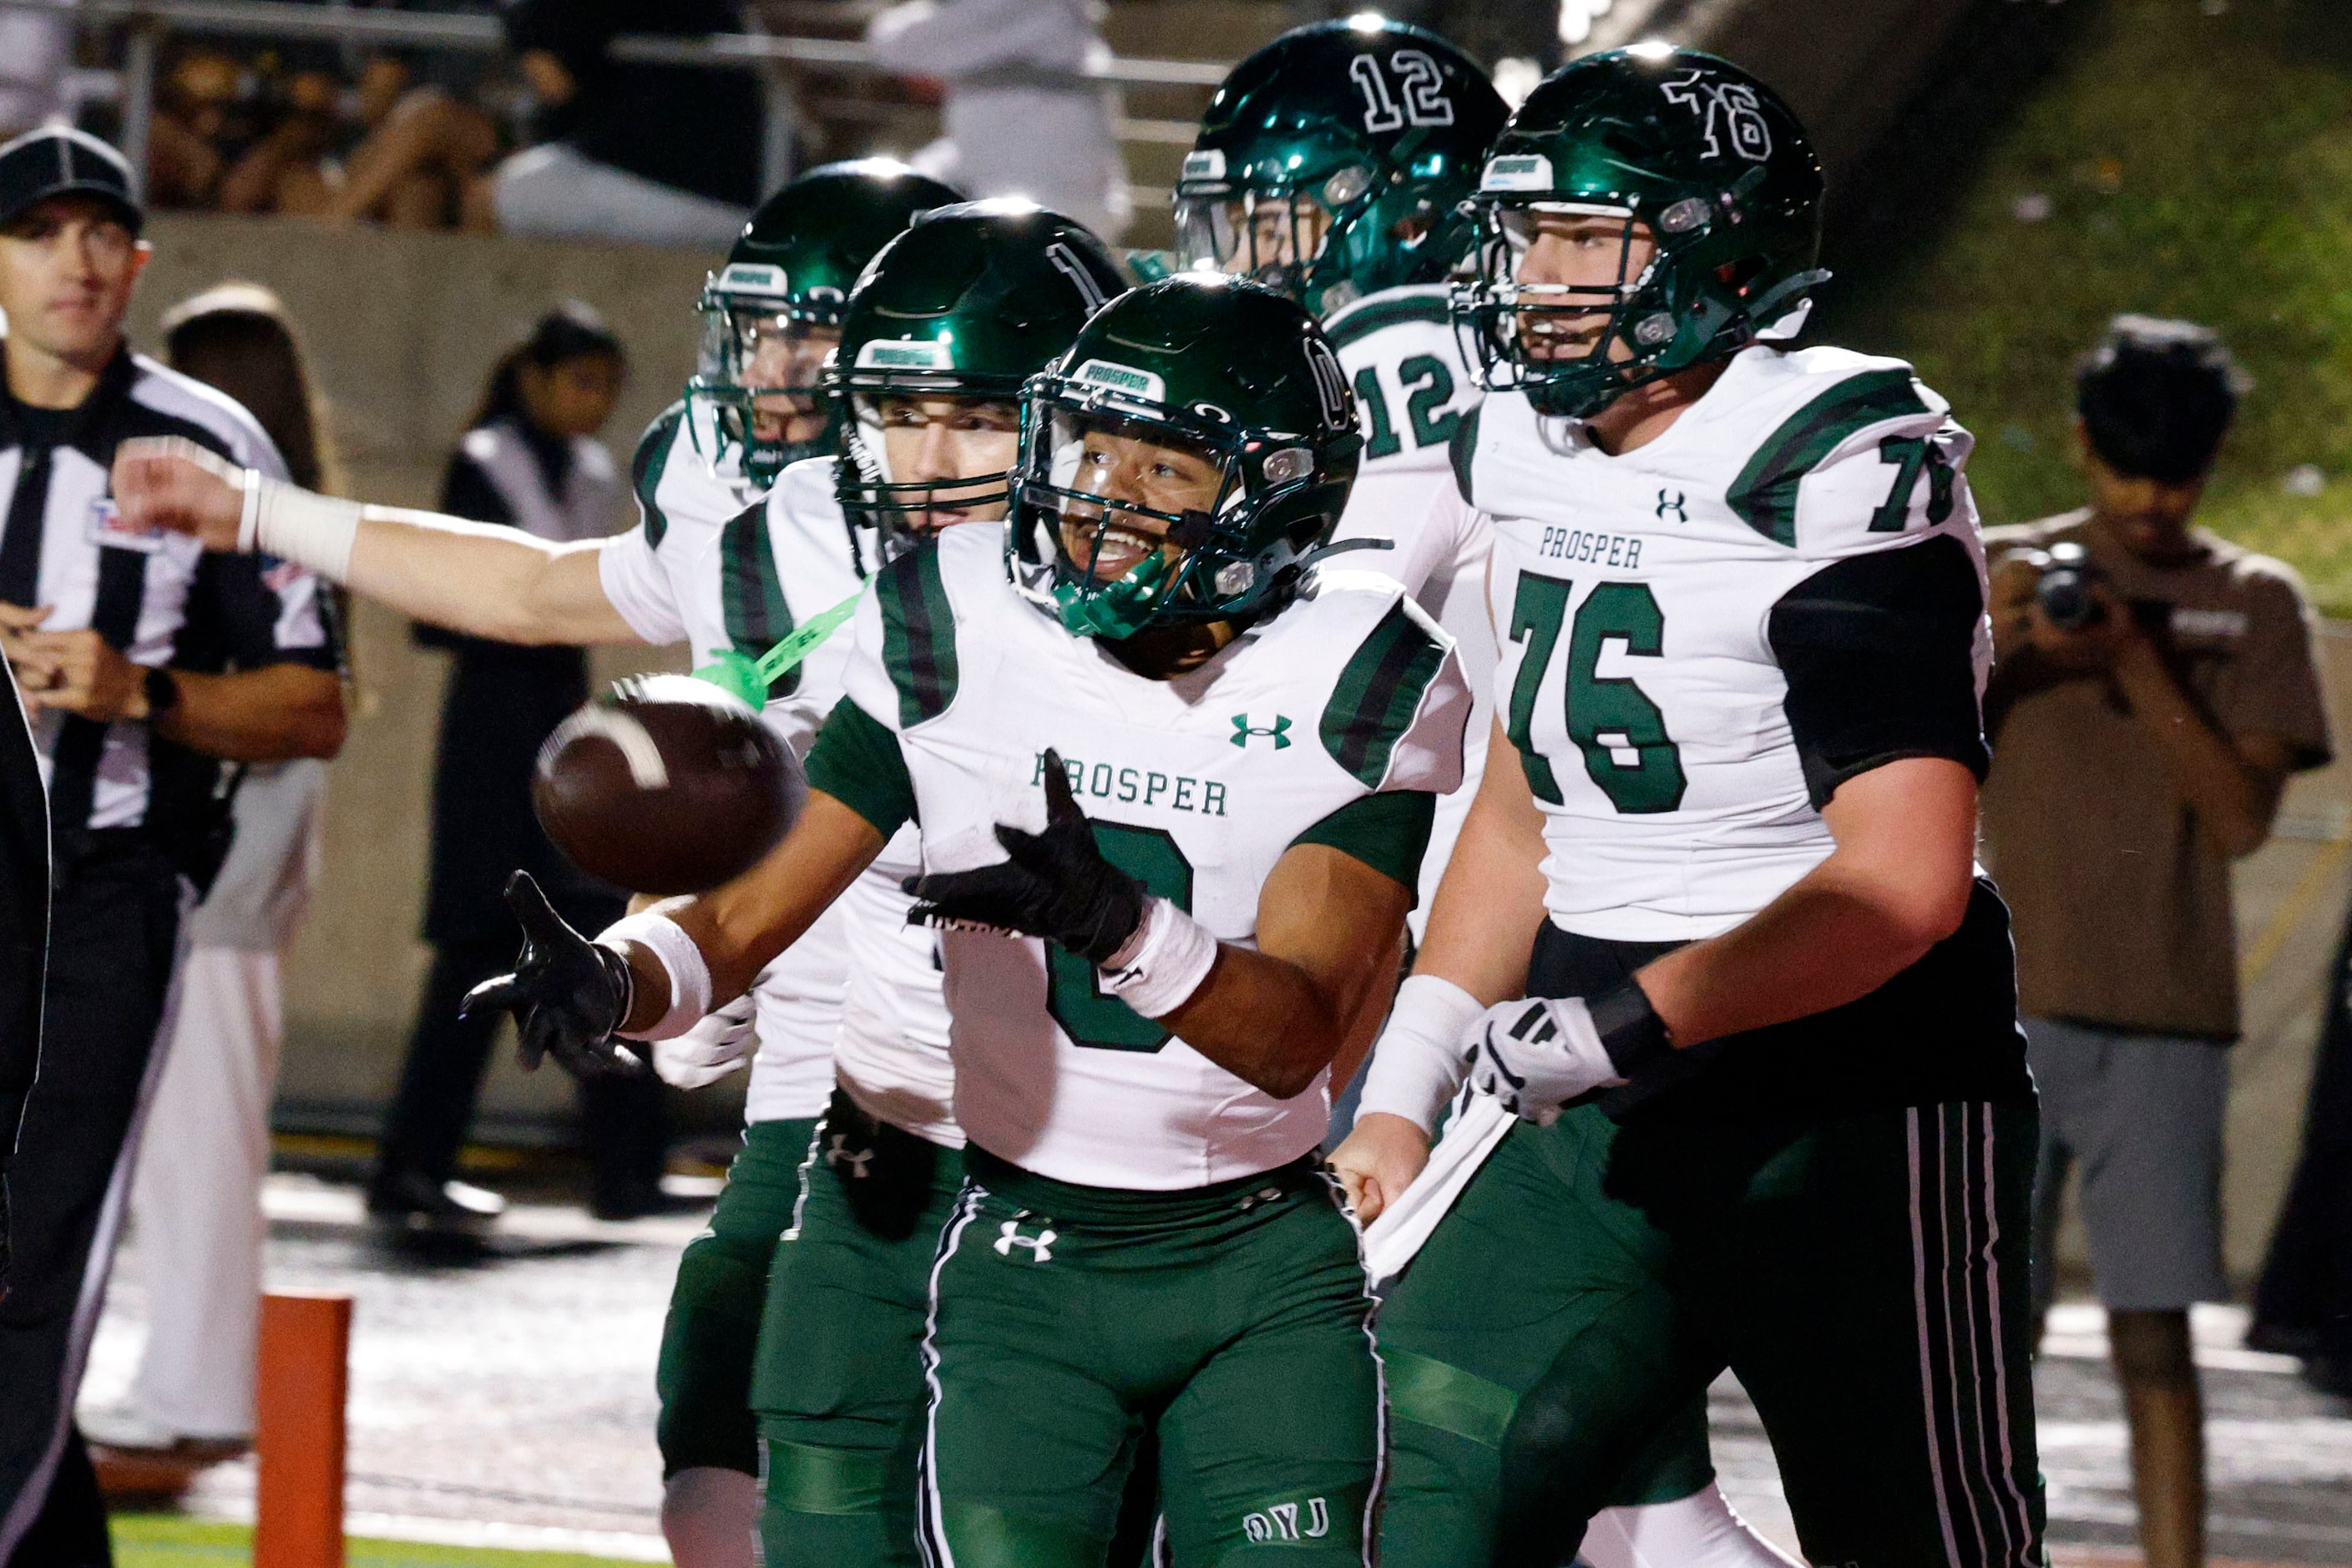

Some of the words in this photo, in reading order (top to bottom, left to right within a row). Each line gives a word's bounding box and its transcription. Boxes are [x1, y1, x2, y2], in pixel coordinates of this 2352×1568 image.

[1349, 50, 1454, 134] 12
[1660, 68, 1773, 162] 76
[1354, 354, 1461, 461] 12
[1540, 526, 1642, 569] PROSPER
[1507, 569, 1688, 814] 76
